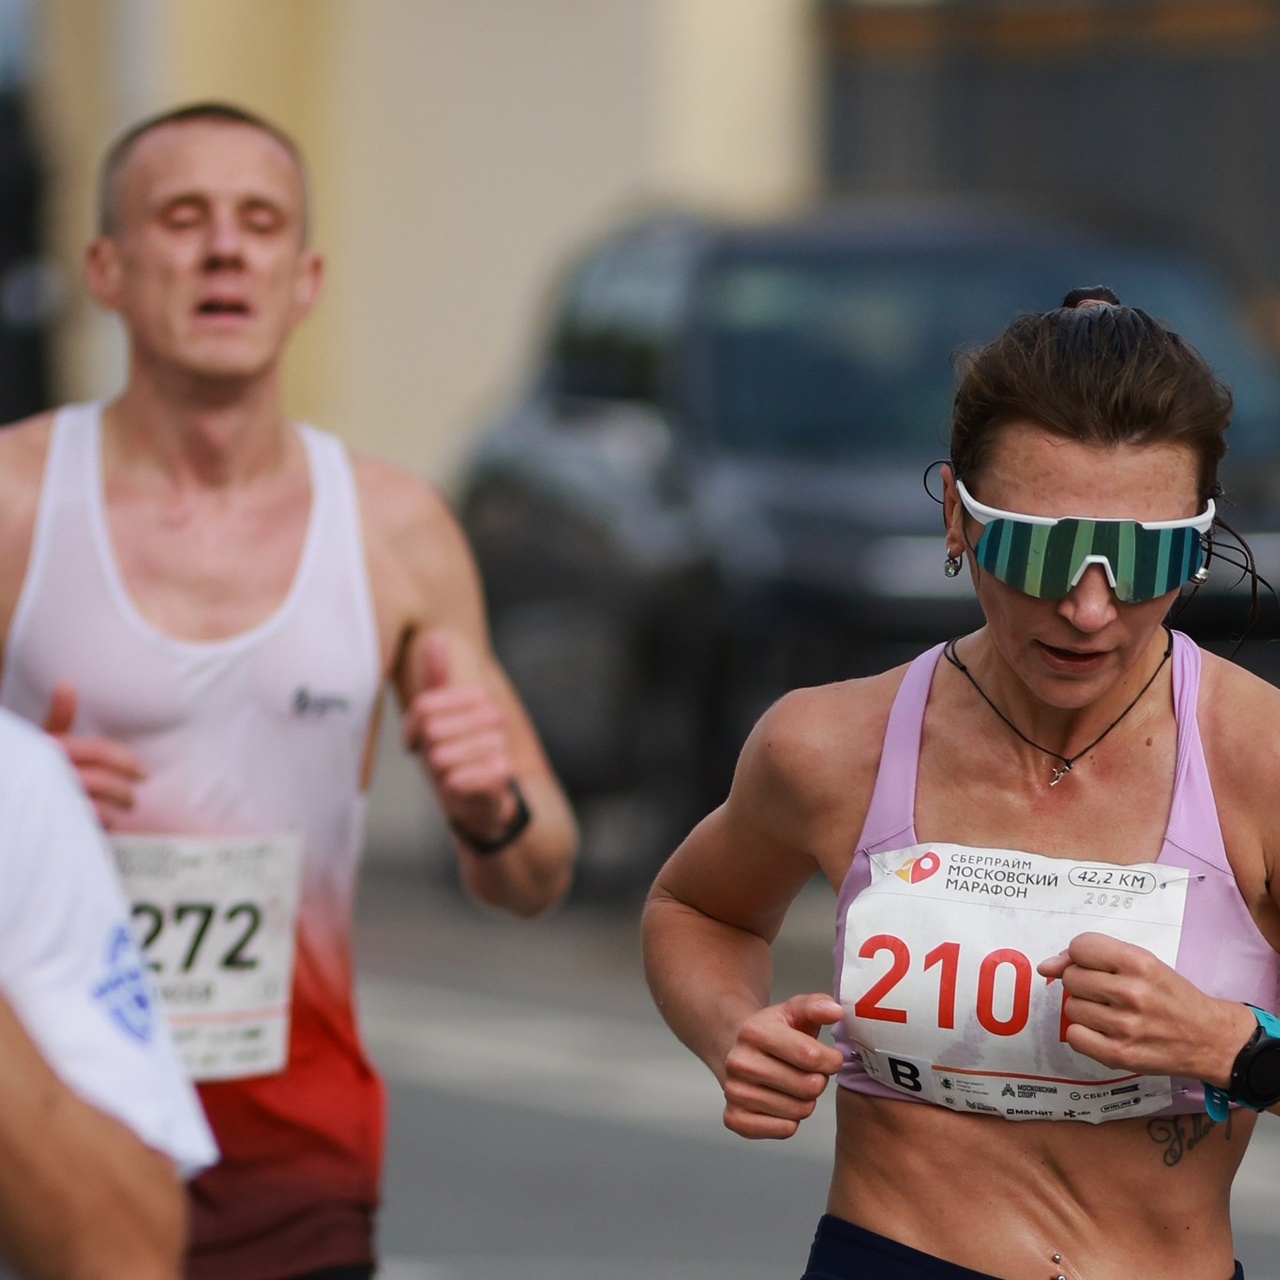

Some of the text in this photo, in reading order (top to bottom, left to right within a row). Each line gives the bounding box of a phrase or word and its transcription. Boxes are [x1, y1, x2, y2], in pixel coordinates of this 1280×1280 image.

[950, 853, 1032, 870] СБЕРПРАЙМ
[948, 865, 1059, 887] МОСКОВСКИЙ
[1077, 870, 1114, 885] 42,2
[945, 878, 1028, 899] МАРАФОН
[1084, 892, 1134, 910] 2026
[854, 934, 1071, 1043] 210
[888, 1057, 922, 1092] B
[1017, 1084, 1058, 1095] МОСКОВСКИЙ
[1083, 1091, 1110, 1100] СБЕР
